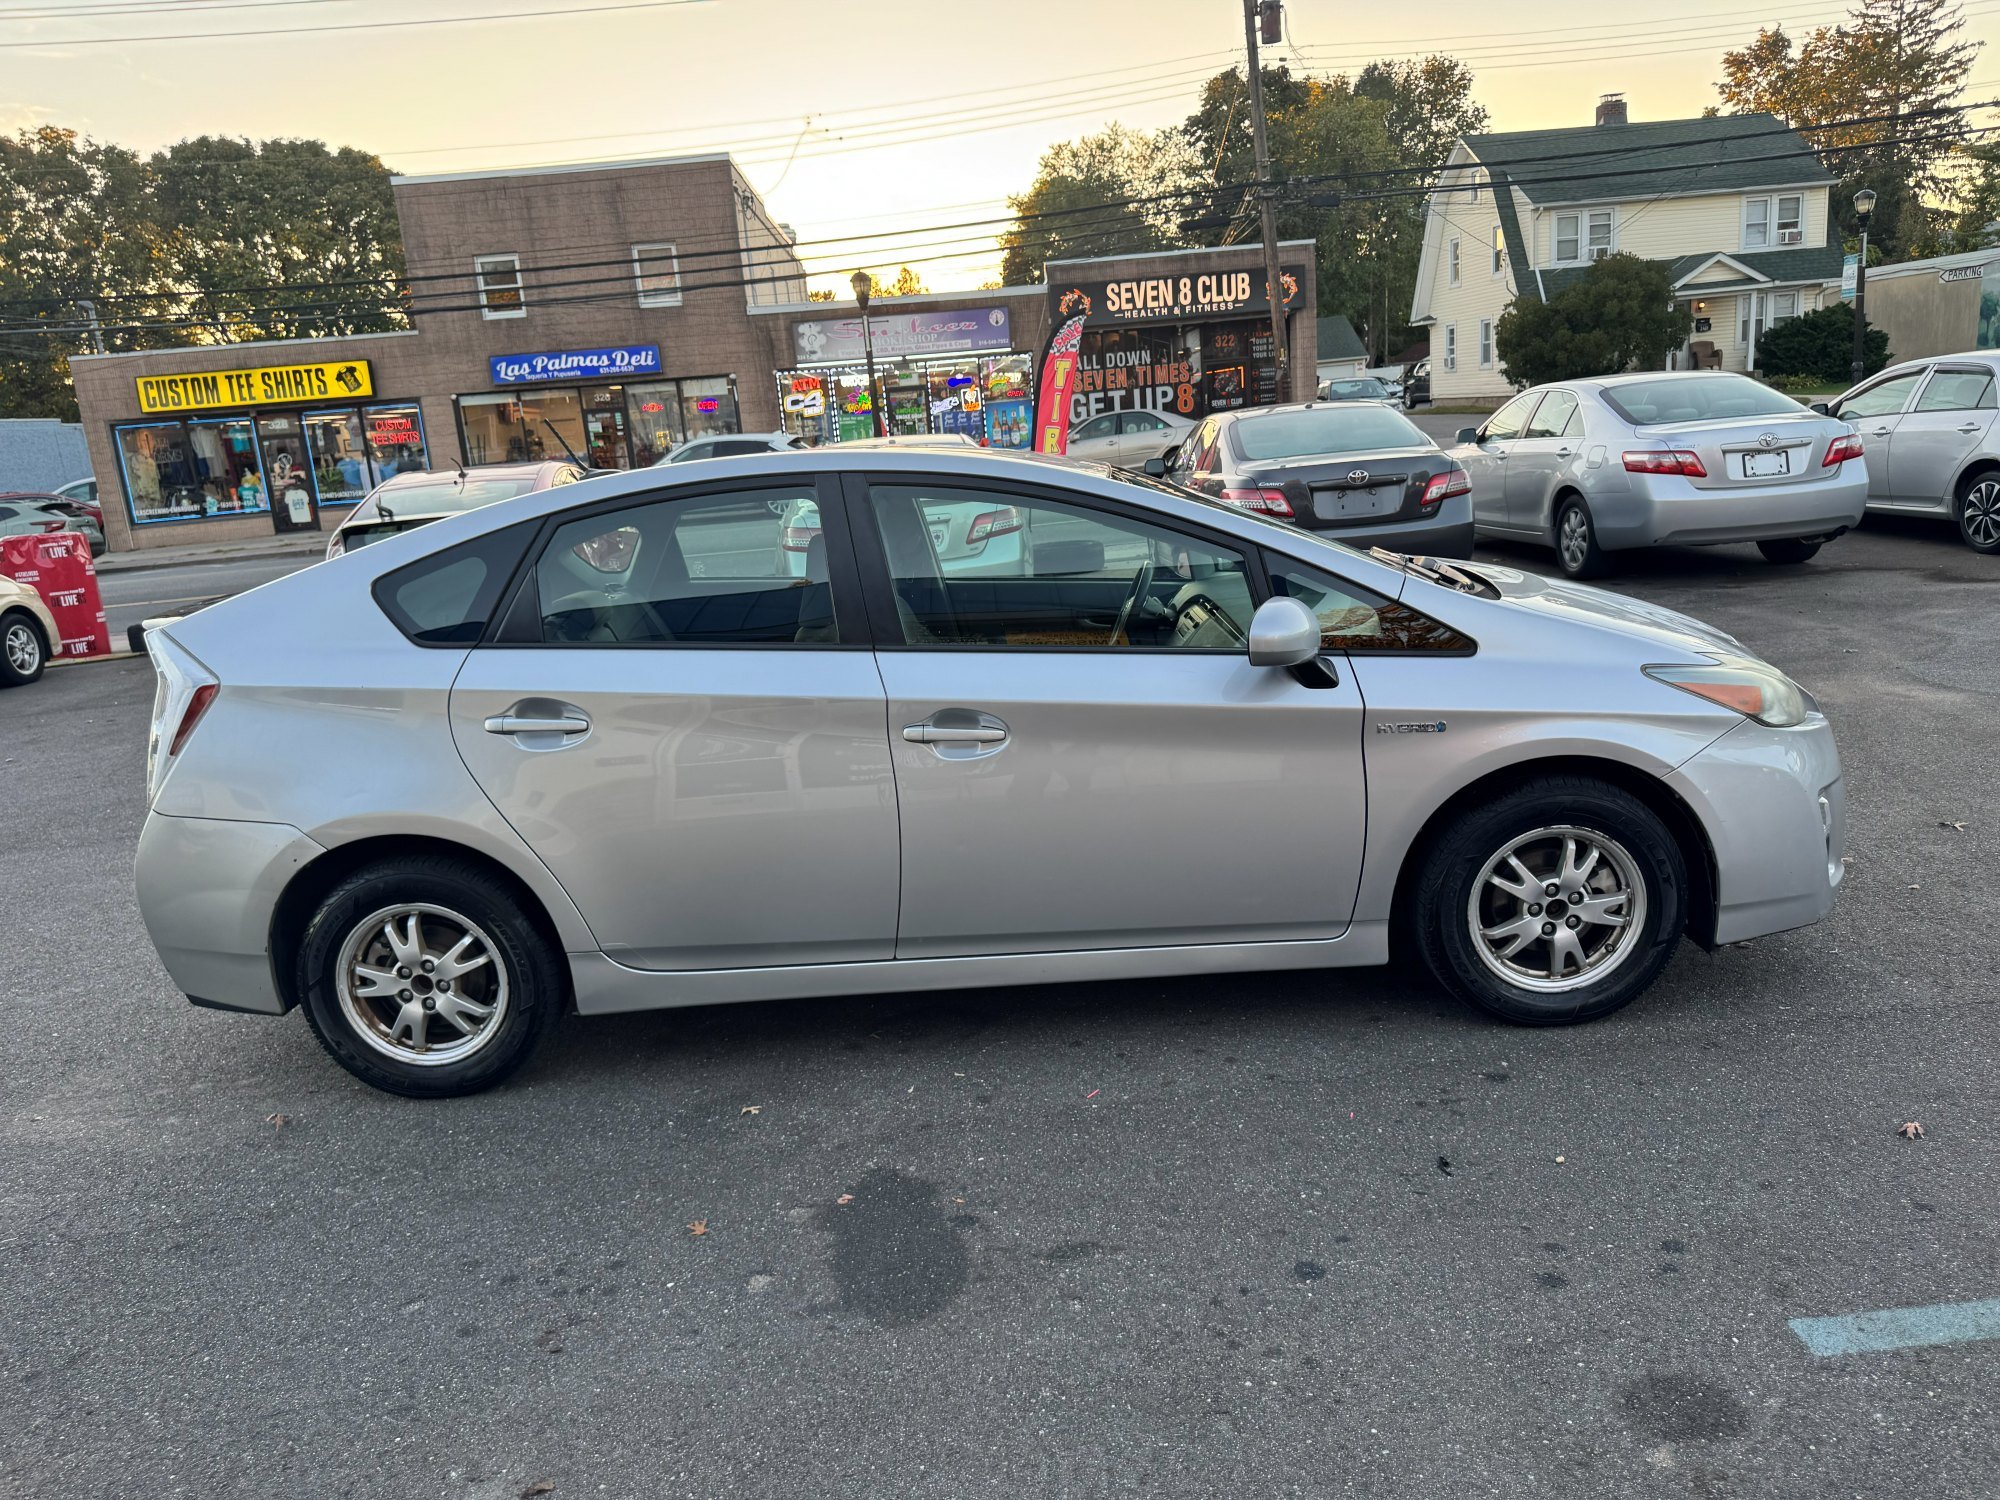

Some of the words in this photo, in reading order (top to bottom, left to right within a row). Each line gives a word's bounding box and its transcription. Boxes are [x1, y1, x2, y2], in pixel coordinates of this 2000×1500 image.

[1948, 265, 1983, 281] PARKING
[1106, 279, 1173, 311] SEVEN
[1179, 277, 1192, 305] 8
[1197, 272, 1250, 304] CLUB
[1125, 307, 1168, 319] HEALTH
[1173, 306, 1180, 315] &
[1186, 302, 1234, 314] FITNESS
[907, 333, 938, 344] SHOP
[1053, 320, 1083, 350] SALE
[1215, 334, 1235, 348] 322
[496, 362, 531, 381] Las
[533, 354, 610, 373] Palmas
[612, 350, 655, 366] Deli
[1076, 354, 1101, 371] ALL
[1106, 350, 1152, 368] DOWN
[525, 372, 548, 381] Taqueria
[554, 369, 581, 379] Pupuseria
[1072, 367, 1128, 393] SEVEN
[1136, 361, 1190, 386] TIMES
[143, 376, 221, 409] CUSTOM
[225, 373, 257, 402] TEE
[261, 367, 328, 400] SHIRTS
[791, 377, 821, 392] ATM
[697, 400, 719, 411] OPEN
[785, 389, 822, 412] C4
[1069, 390, 1126, 424] GET
[1133, 386, 1174, 411] UP
[1177, 383, 1195, 413] 8
[1211, 399, 1227, 407] SEVEN
[1230, 397, 1243, 405] CLUB
[375, 417, 412, 432] CUSTOM
[372, 432, 389, 446] TEE
[389, 431, 420, 445] SHIRTS
[1376, 722, 1437, 734] HYBRID
